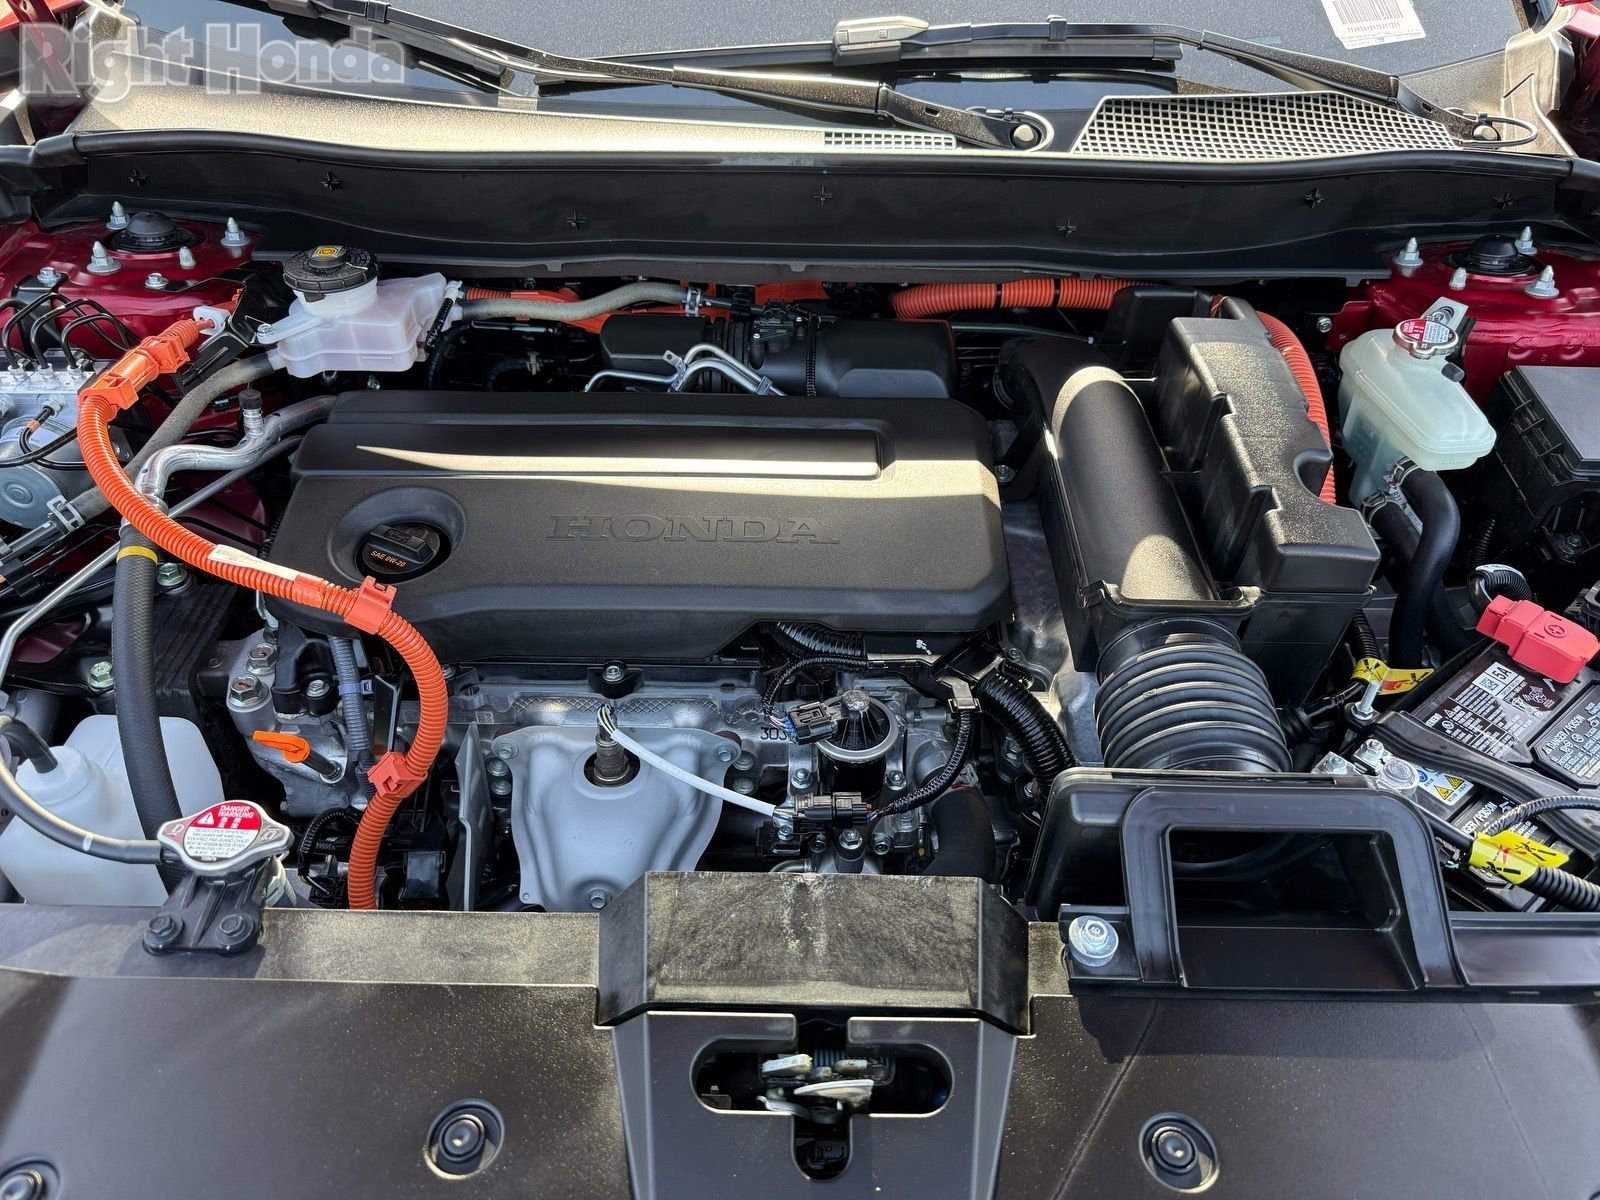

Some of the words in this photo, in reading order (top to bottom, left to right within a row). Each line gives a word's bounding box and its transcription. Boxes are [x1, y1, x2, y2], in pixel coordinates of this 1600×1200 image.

[546, 514, 839, 545] HONDA
[370, 550, 386, 559] SAE
[1491, 666, 1512, 681] 5A
